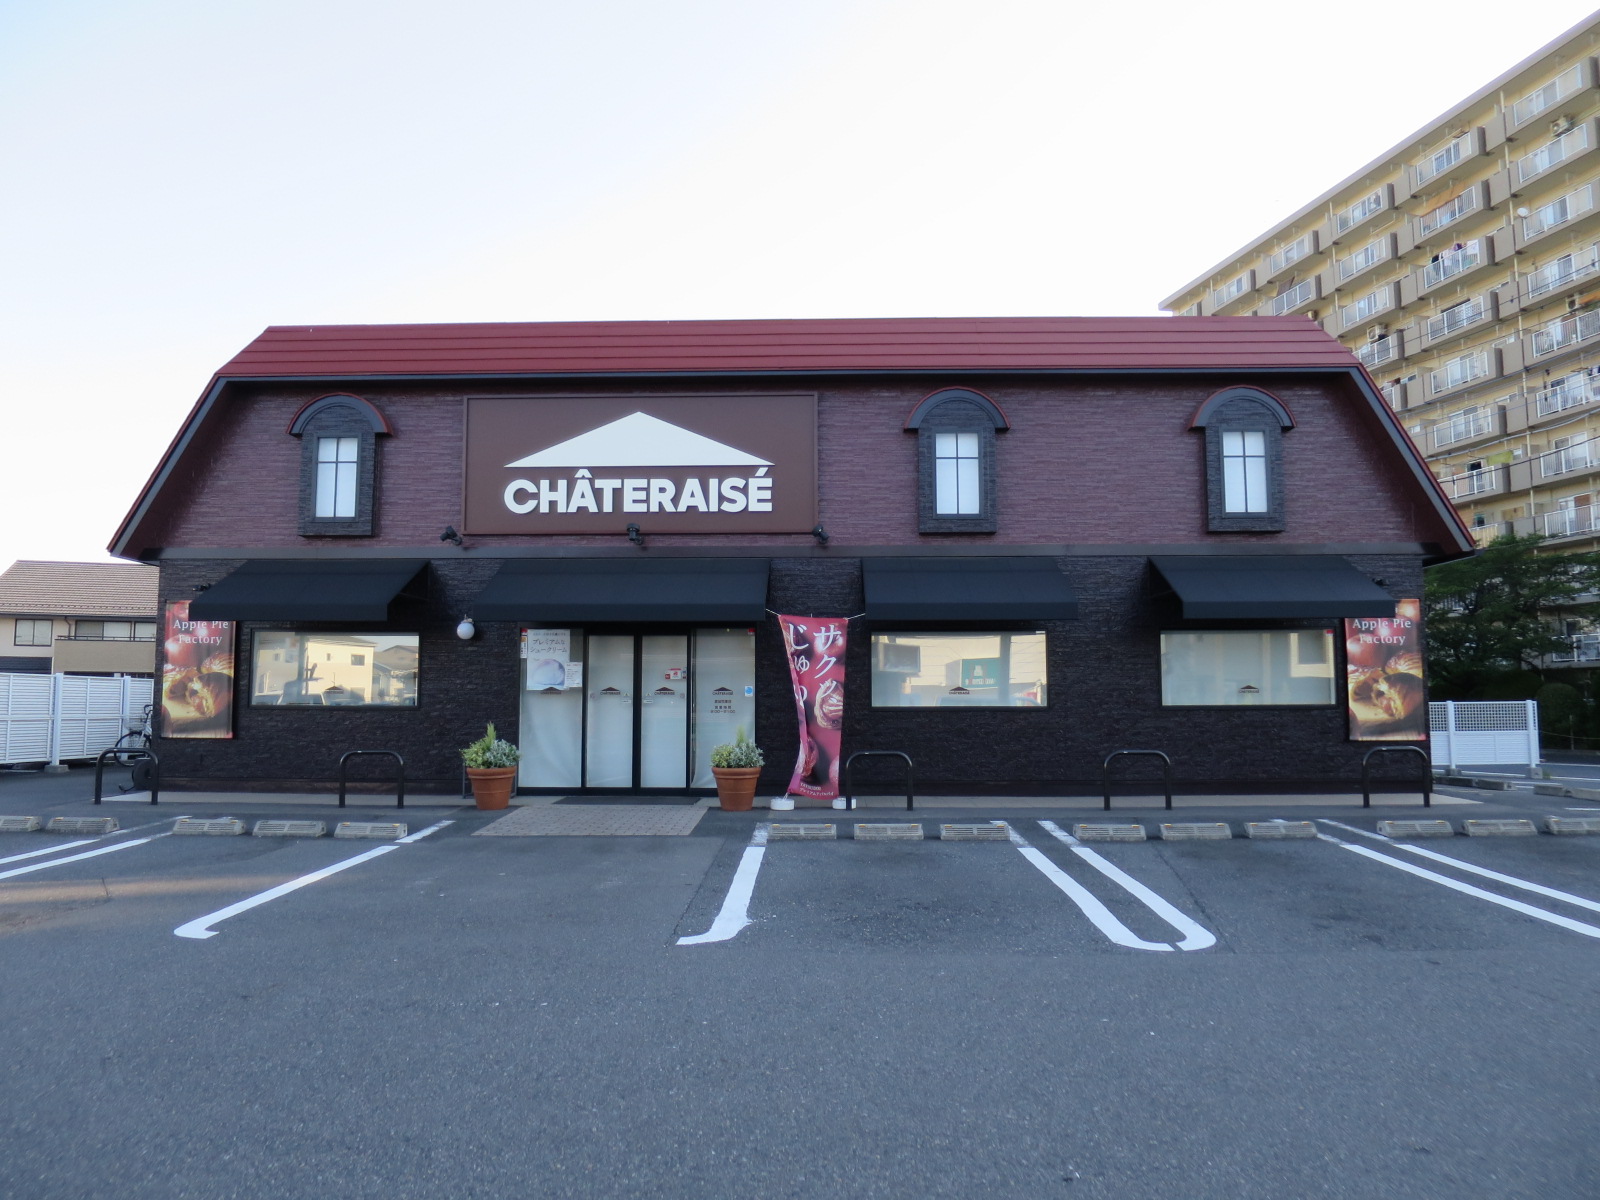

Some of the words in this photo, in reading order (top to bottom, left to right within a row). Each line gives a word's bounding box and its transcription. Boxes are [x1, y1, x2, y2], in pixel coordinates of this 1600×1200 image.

[504, 467, 772, 513] CHÂTERAISÉ
[173, 620, 206, 630] Apple
[1352, 618, 1388, 630] Apple
[1393, 618, 1412, 628] Pie
[178, 635, 222, 645] Factory
[1360, 635, 1405, 645] Factory
